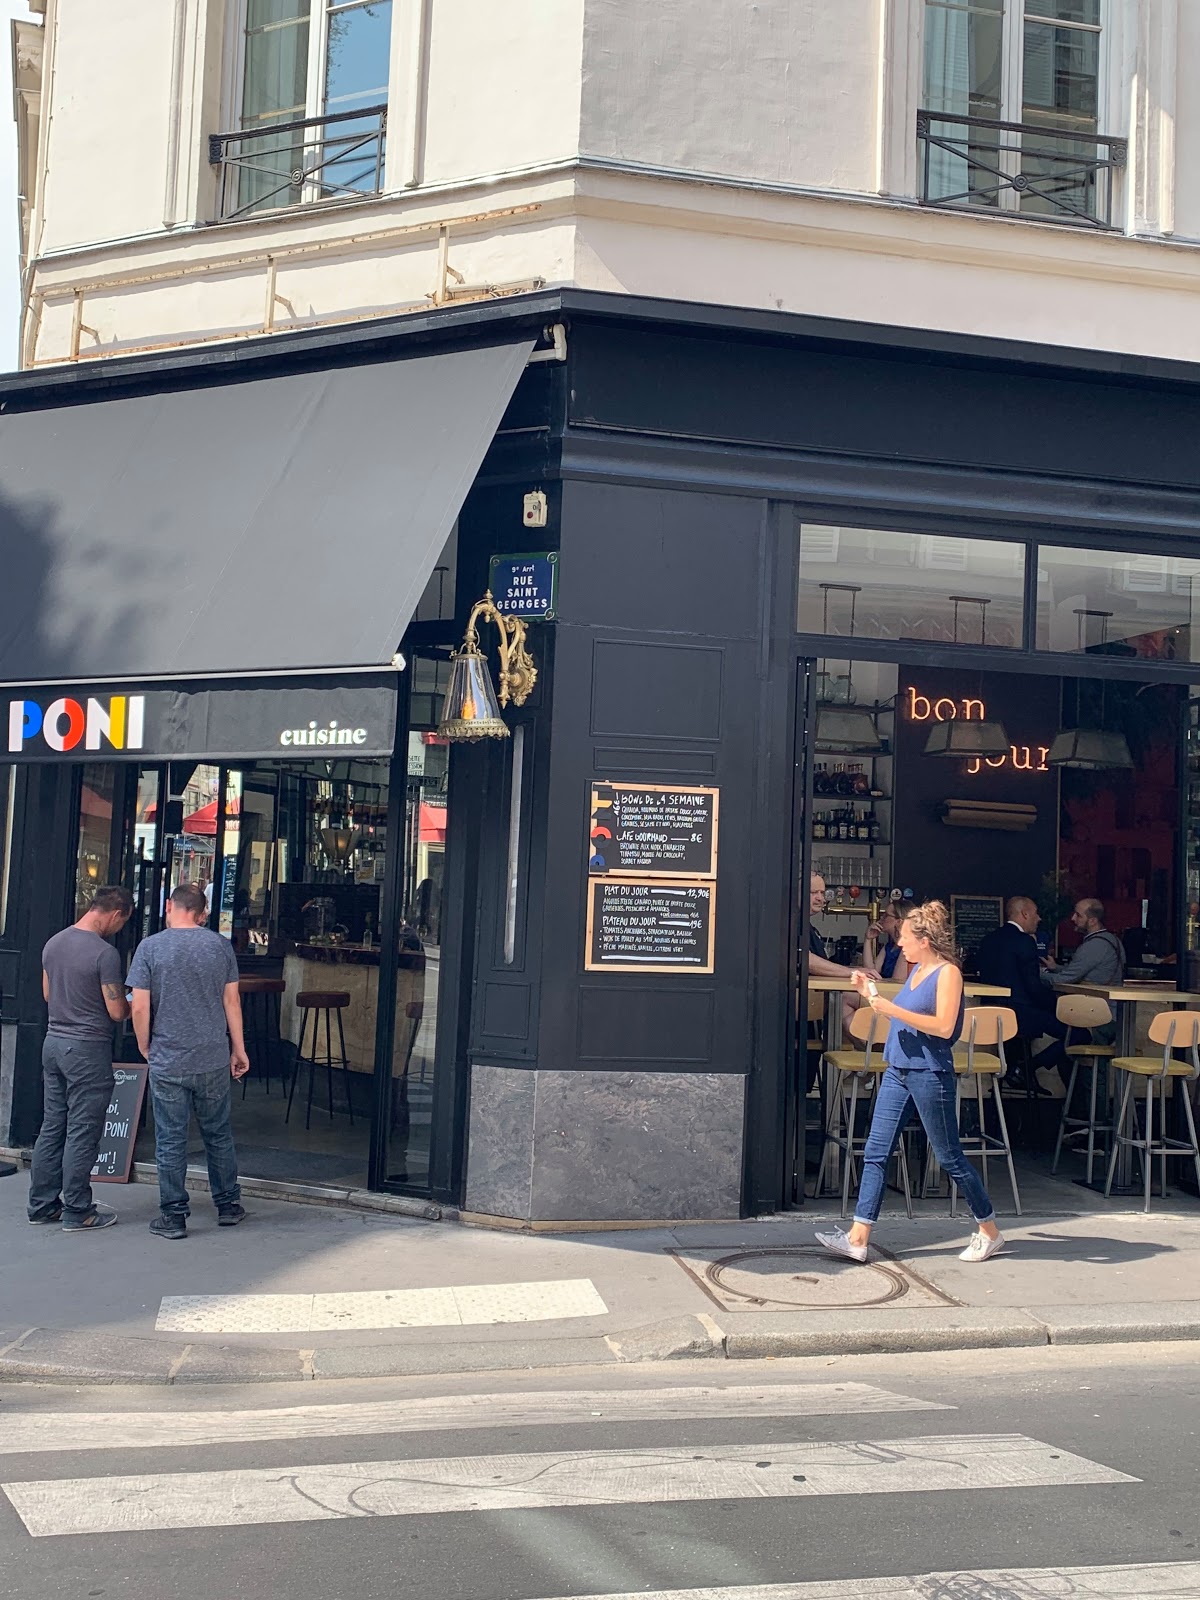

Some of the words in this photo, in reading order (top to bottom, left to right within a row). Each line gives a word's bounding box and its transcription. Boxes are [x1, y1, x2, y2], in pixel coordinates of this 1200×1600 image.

[513, 576, 533, 586] RUE
[507, 587, 538, 598] SAINT
[496, 598, 548, 610] GEORGES
[908, 686, 985, 721] bon
[8, 695, 145, 752] PONI
[280, 720, 367, 746] cuisine
[668, 794, 705, 806] SEMAINE
[616, 830, 634, 841] CAFÉ
[634, 832, 668, 843] GOURMAND
[690, 832, 703, 843] 8€
[604, 885, 620, 896] PLAT
[620, 886, 631, 896] DU
[630, 887, 649, 897] JOUR
[602, 915, 629, 926] PLATEAU
[629, 917, 639, 926] DU
[638, 917, 657, 927] JOUR
